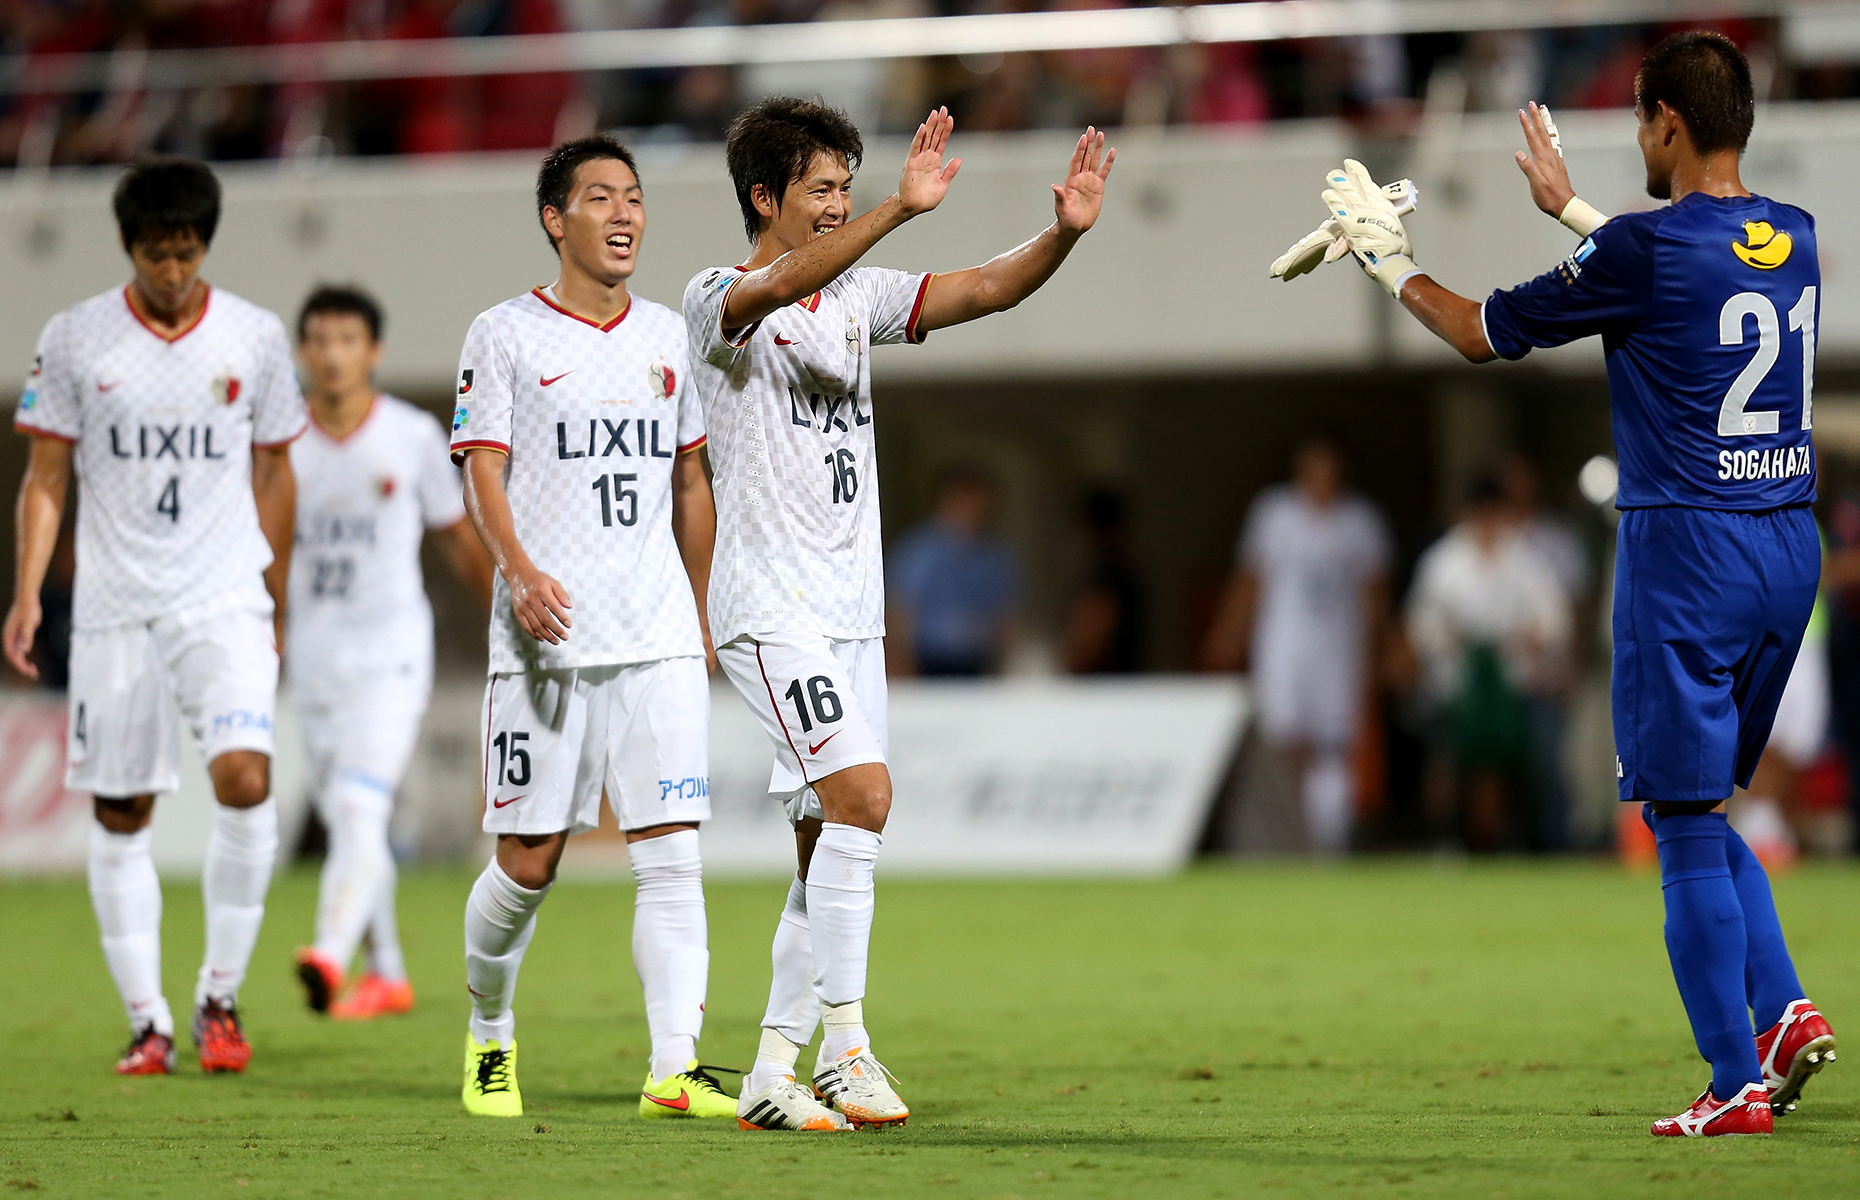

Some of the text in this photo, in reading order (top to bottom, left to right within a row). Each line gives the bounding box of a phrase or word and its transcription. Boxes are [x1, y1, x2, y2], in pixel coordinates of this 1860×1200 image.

[1718, 286, 1816, 436] 21
[110, 424, 226, 460] LIXIL
[557, 419, 672, 460] LIXIL
[1718, 445, 1810, 480] SOGAHATA
[825, 448, 858, 503] 16
[157, 476, 180, 523] 4
[592, 473, 638, 527] 15
[76, 701, 87, 748] 4
[785, 675, 843, 733] 16
[494, 731, 531, 786] 15
[659, 776, 710, 801] アイフル
